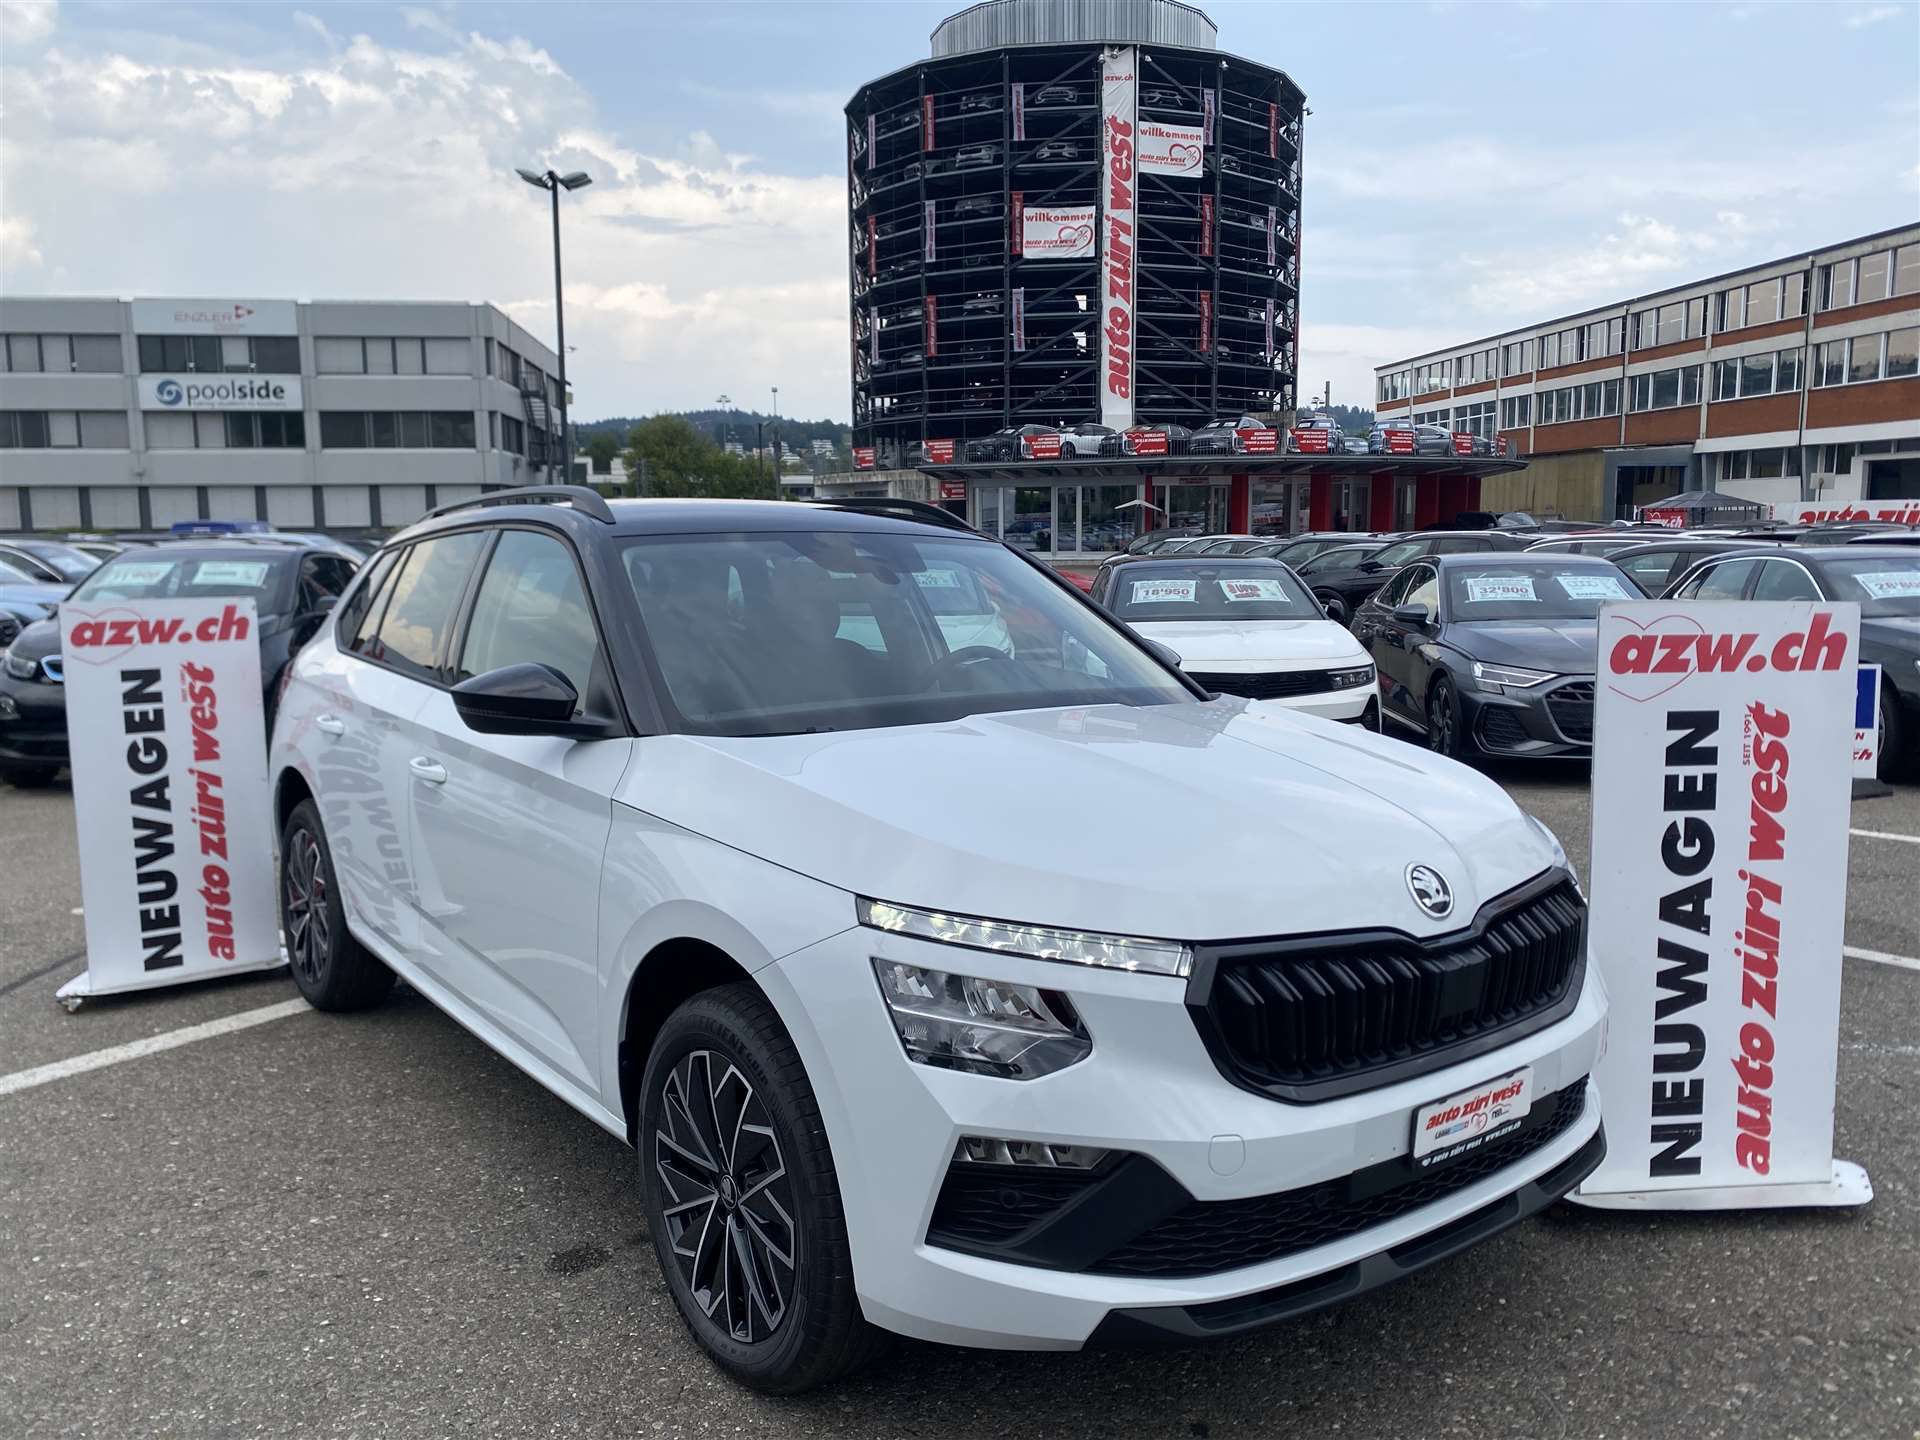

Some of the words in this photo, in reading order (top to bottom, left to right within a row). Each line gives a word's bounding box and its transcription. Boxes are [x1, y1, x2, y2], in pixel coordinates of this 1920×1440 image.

[1104, 73, 1134, 82] azw.ch
[1107, 115, 1132, 209] west
[1139, 127, 1202, 141] willkommen
[1024, 212, 1093, 222] willkommen
[1104, 213, 1132, 306] züri
[174, 312, 233, 321] ENZLER
[1103, 306, 1130, 400] auto
[187, 379, 285, 406] poolside
[1143, 588, 1190, 596] 18'950
[1479, 586, 1529, 594] 32'800
[70, 604, 249, 647] azw.ch
[1609, 612, 1848, 675] azw.ch
[182, 661, 222, 761] west
[1743, 713, 1752, 740] 1991
[1742, 743, 1750, 766] SEIT
[1746, 700, 1790, 860] west
[120, 667, 184, 972] NEUWAGEN
[187, 767, 228, 861] züri
[197, 863, 236, 960] auto
[1649, 710, 1720, 1178] NEUWAGEN
[1733, 868, 1783, 1021] züri
[1426, 1105, 1461, 1131] auto
[1460, 1091, 1492, 1117] züri
[1492, 1079, 1524, 1105] west
[1730, 1022, 1775, 1176] auto
